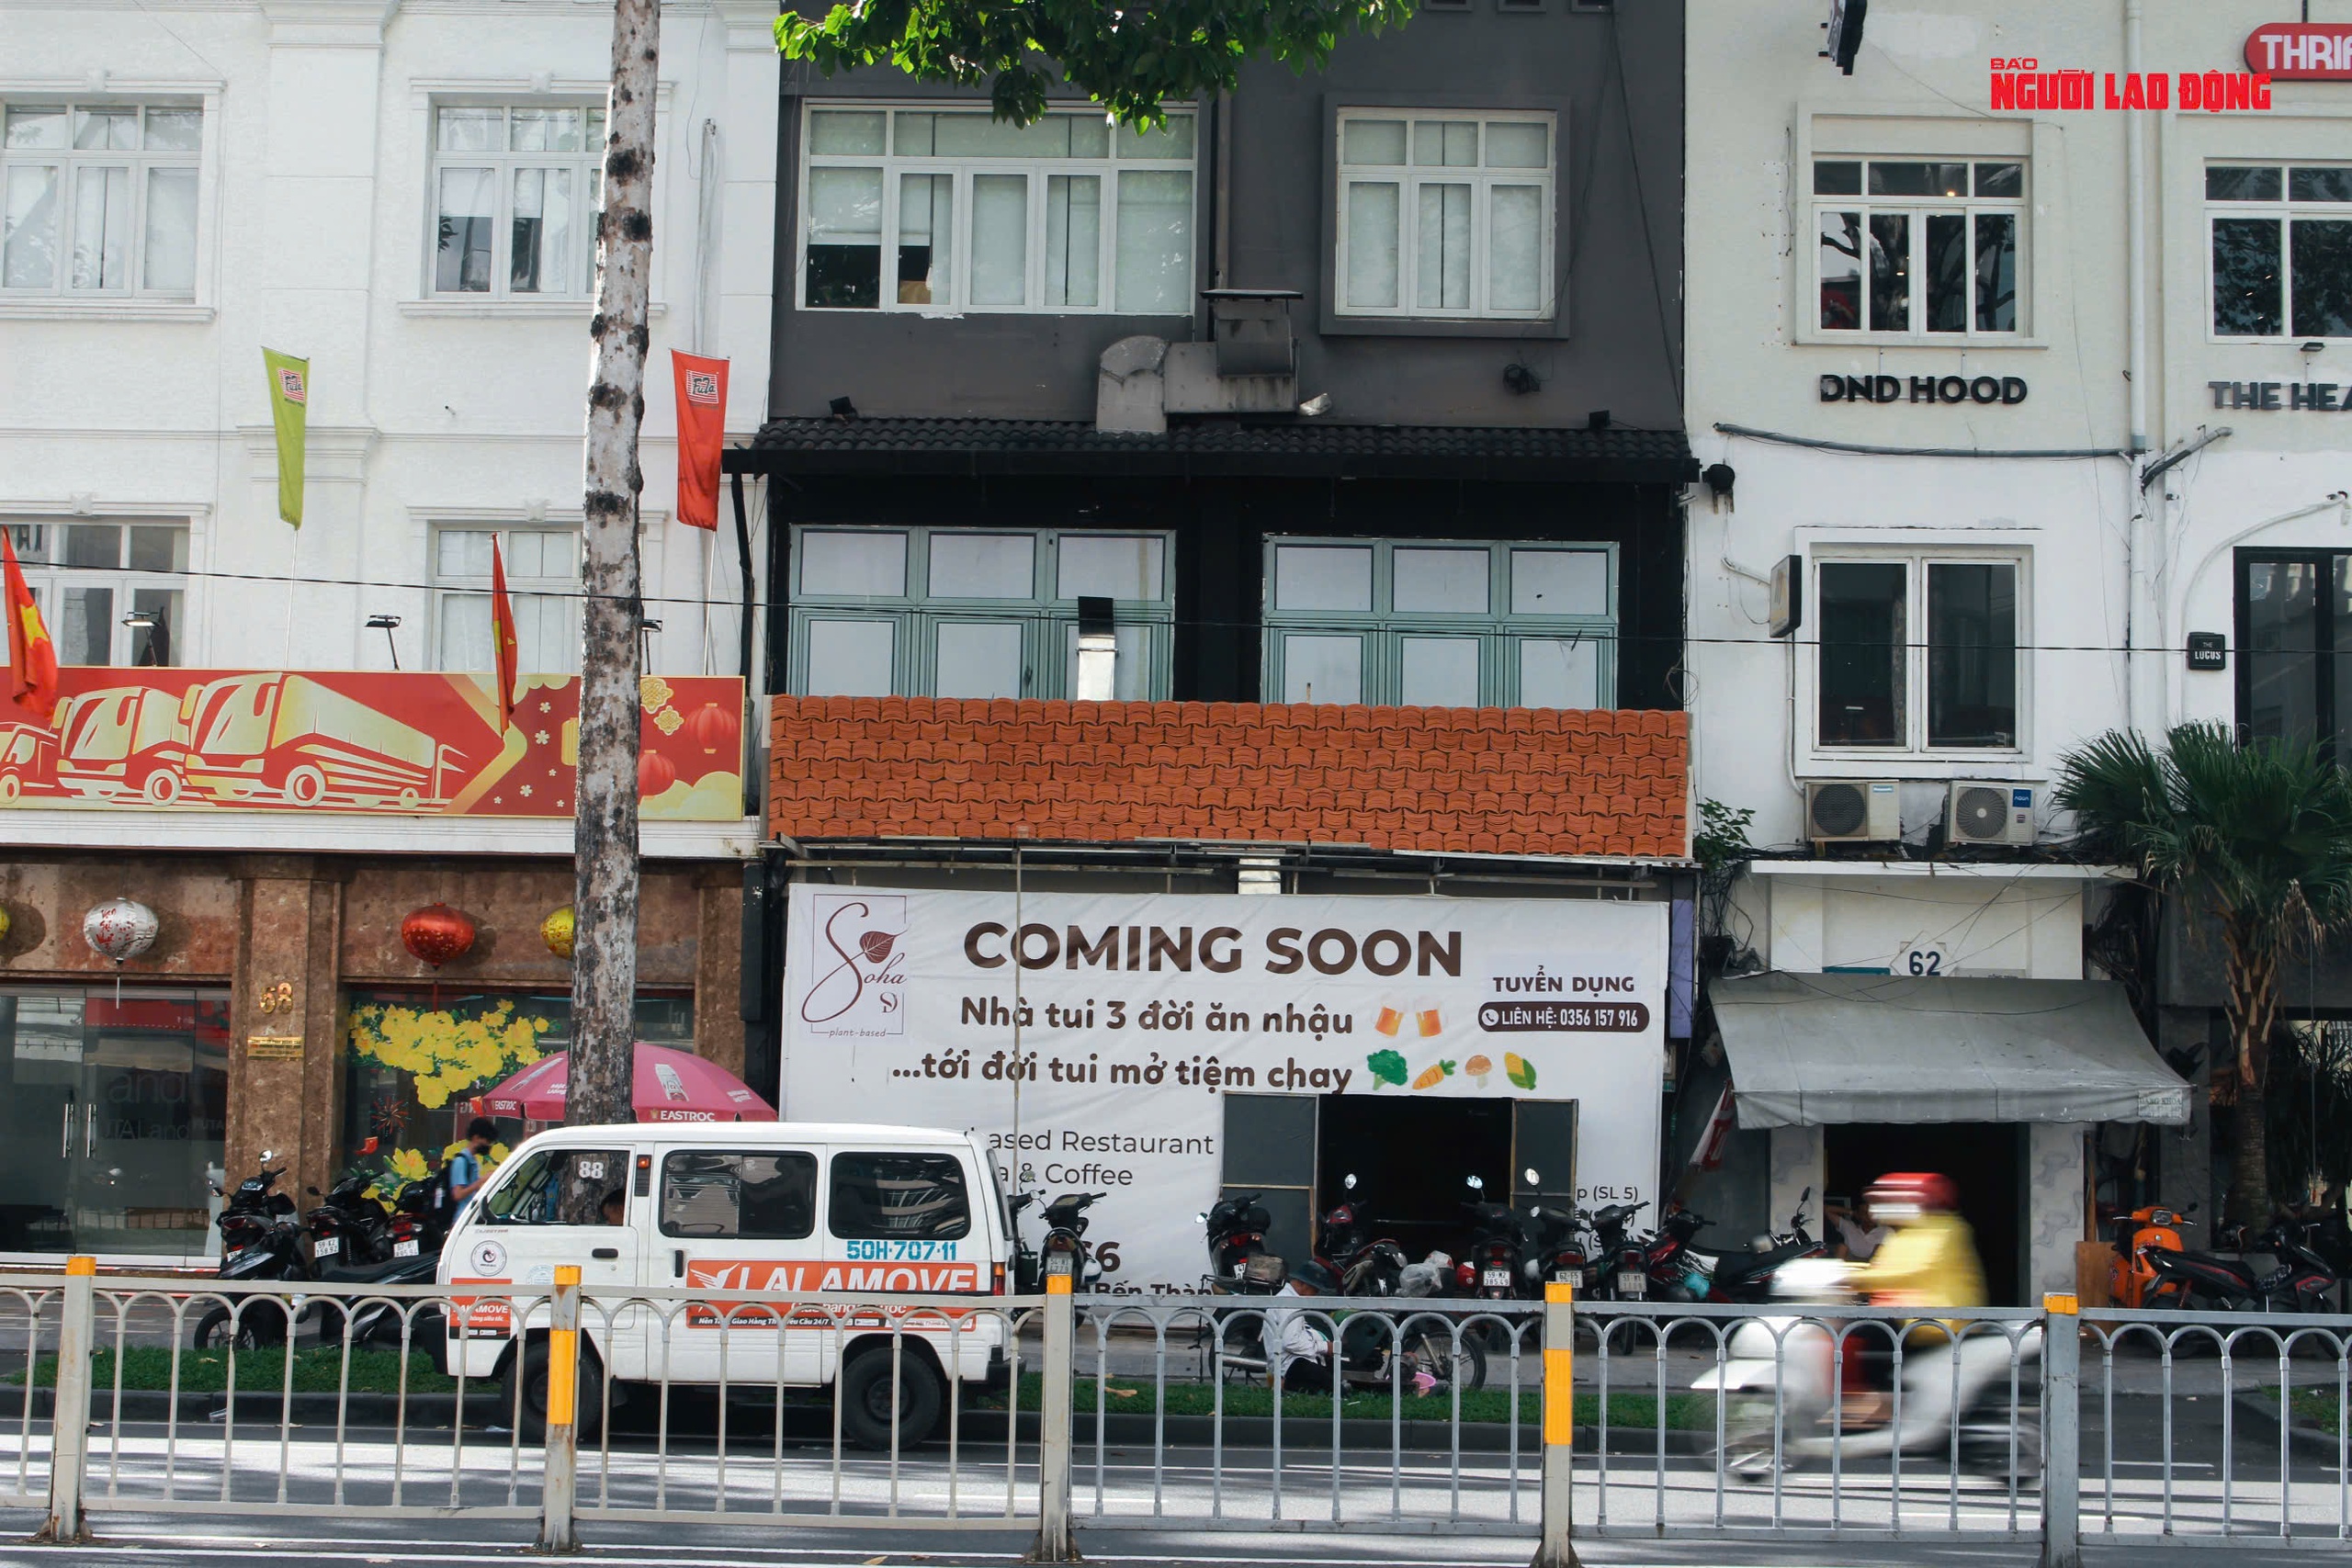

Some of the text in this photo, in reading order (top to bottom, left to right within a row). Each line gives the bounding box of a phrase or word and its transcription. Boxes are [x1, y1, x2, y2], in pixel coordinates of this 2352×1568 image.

[1909, 375, 2029, 404] HOOD
[2208, 381, 2281, 411] THE
[964, 921, 1462, 977] COMING SOON
[1908, 950, 1941, 976] 62
[1493, 964, 1635, 998] TUYỂN DỤNG
[961, 995, 1352, 1042] Nhà tui 3 đời ăn nhậu
[1501, 1007, 1532, 1026] LIÊN
[1560, 1008, 1591, 1027] 0356
[1594, 1008, 1614, 1027] 157
[1618, 1010, 1638, 1028] 916
[829, 1027, 888, 1038] plant-based
[981, 1050, 1037, 1082] đời
[1048, 1053, 1098, 1084] tui
[1110, 1052, 1168, 1086] mở
[1174, 1055, 1256, 1095] tiệm
[1267, 1056, 1352, 1095] chay
[660, 1110, 716, 1122] EASTROC
[989, 1129, 1215, 1155] ased Restaurant
[578, 1161, 604, 1179] 88
[1045, 1163, 1133, 1186] Coffee
[1593, 1185, 1619, 1202] (SL
[1623, 1186, 1638, 1202] 5)
[739, 1267, 975, 1292] LALAMOVE
[1149, 1282, 1213, 1295] Thàn
